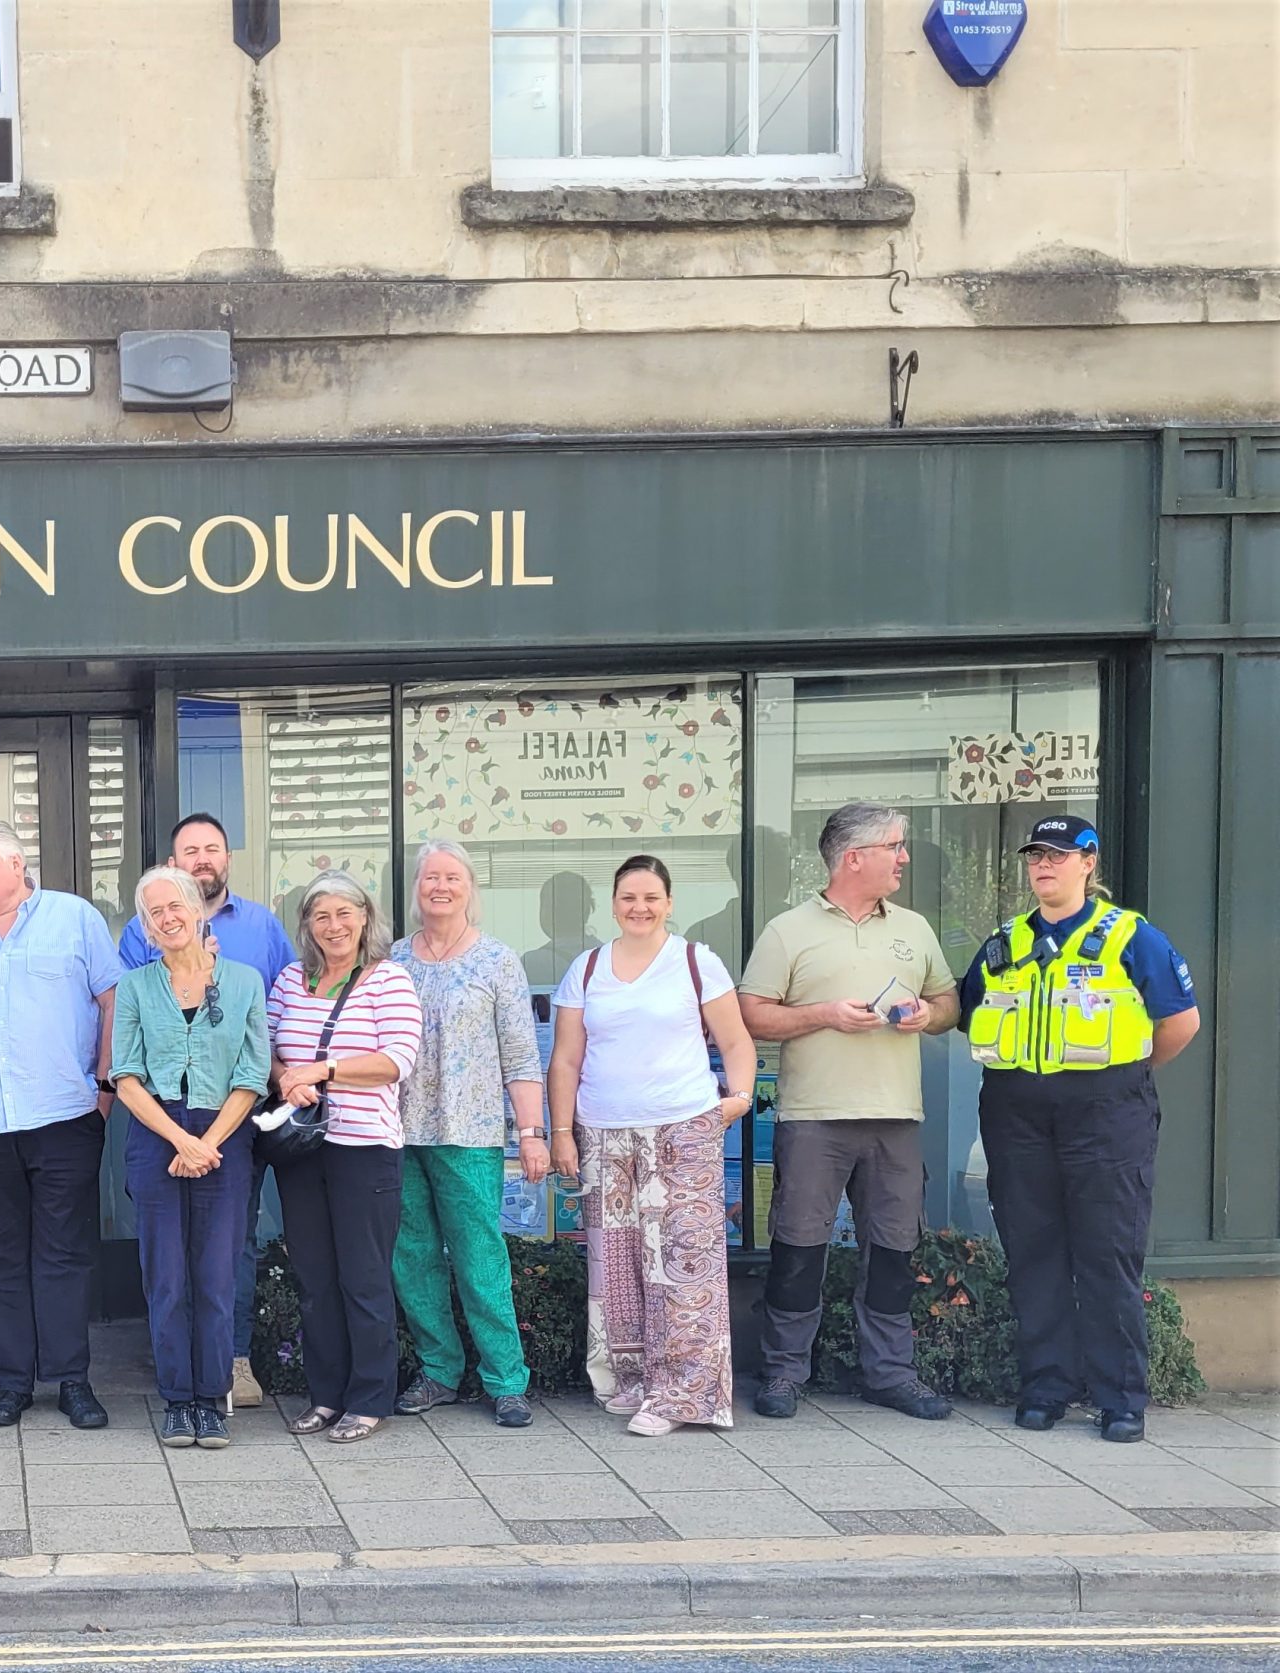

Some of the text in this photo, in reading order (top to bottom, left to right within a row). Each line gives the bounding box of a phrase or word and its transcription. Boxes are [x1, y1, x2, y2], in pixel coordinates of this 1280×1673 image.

[956, 0, 1022, 11] Stroud Alarms
[953, 25, 1012, 34] 01453 750519
[118, 509, 554, 596] COUNCIL
[1037, 821, 1067, 832] PCSO
